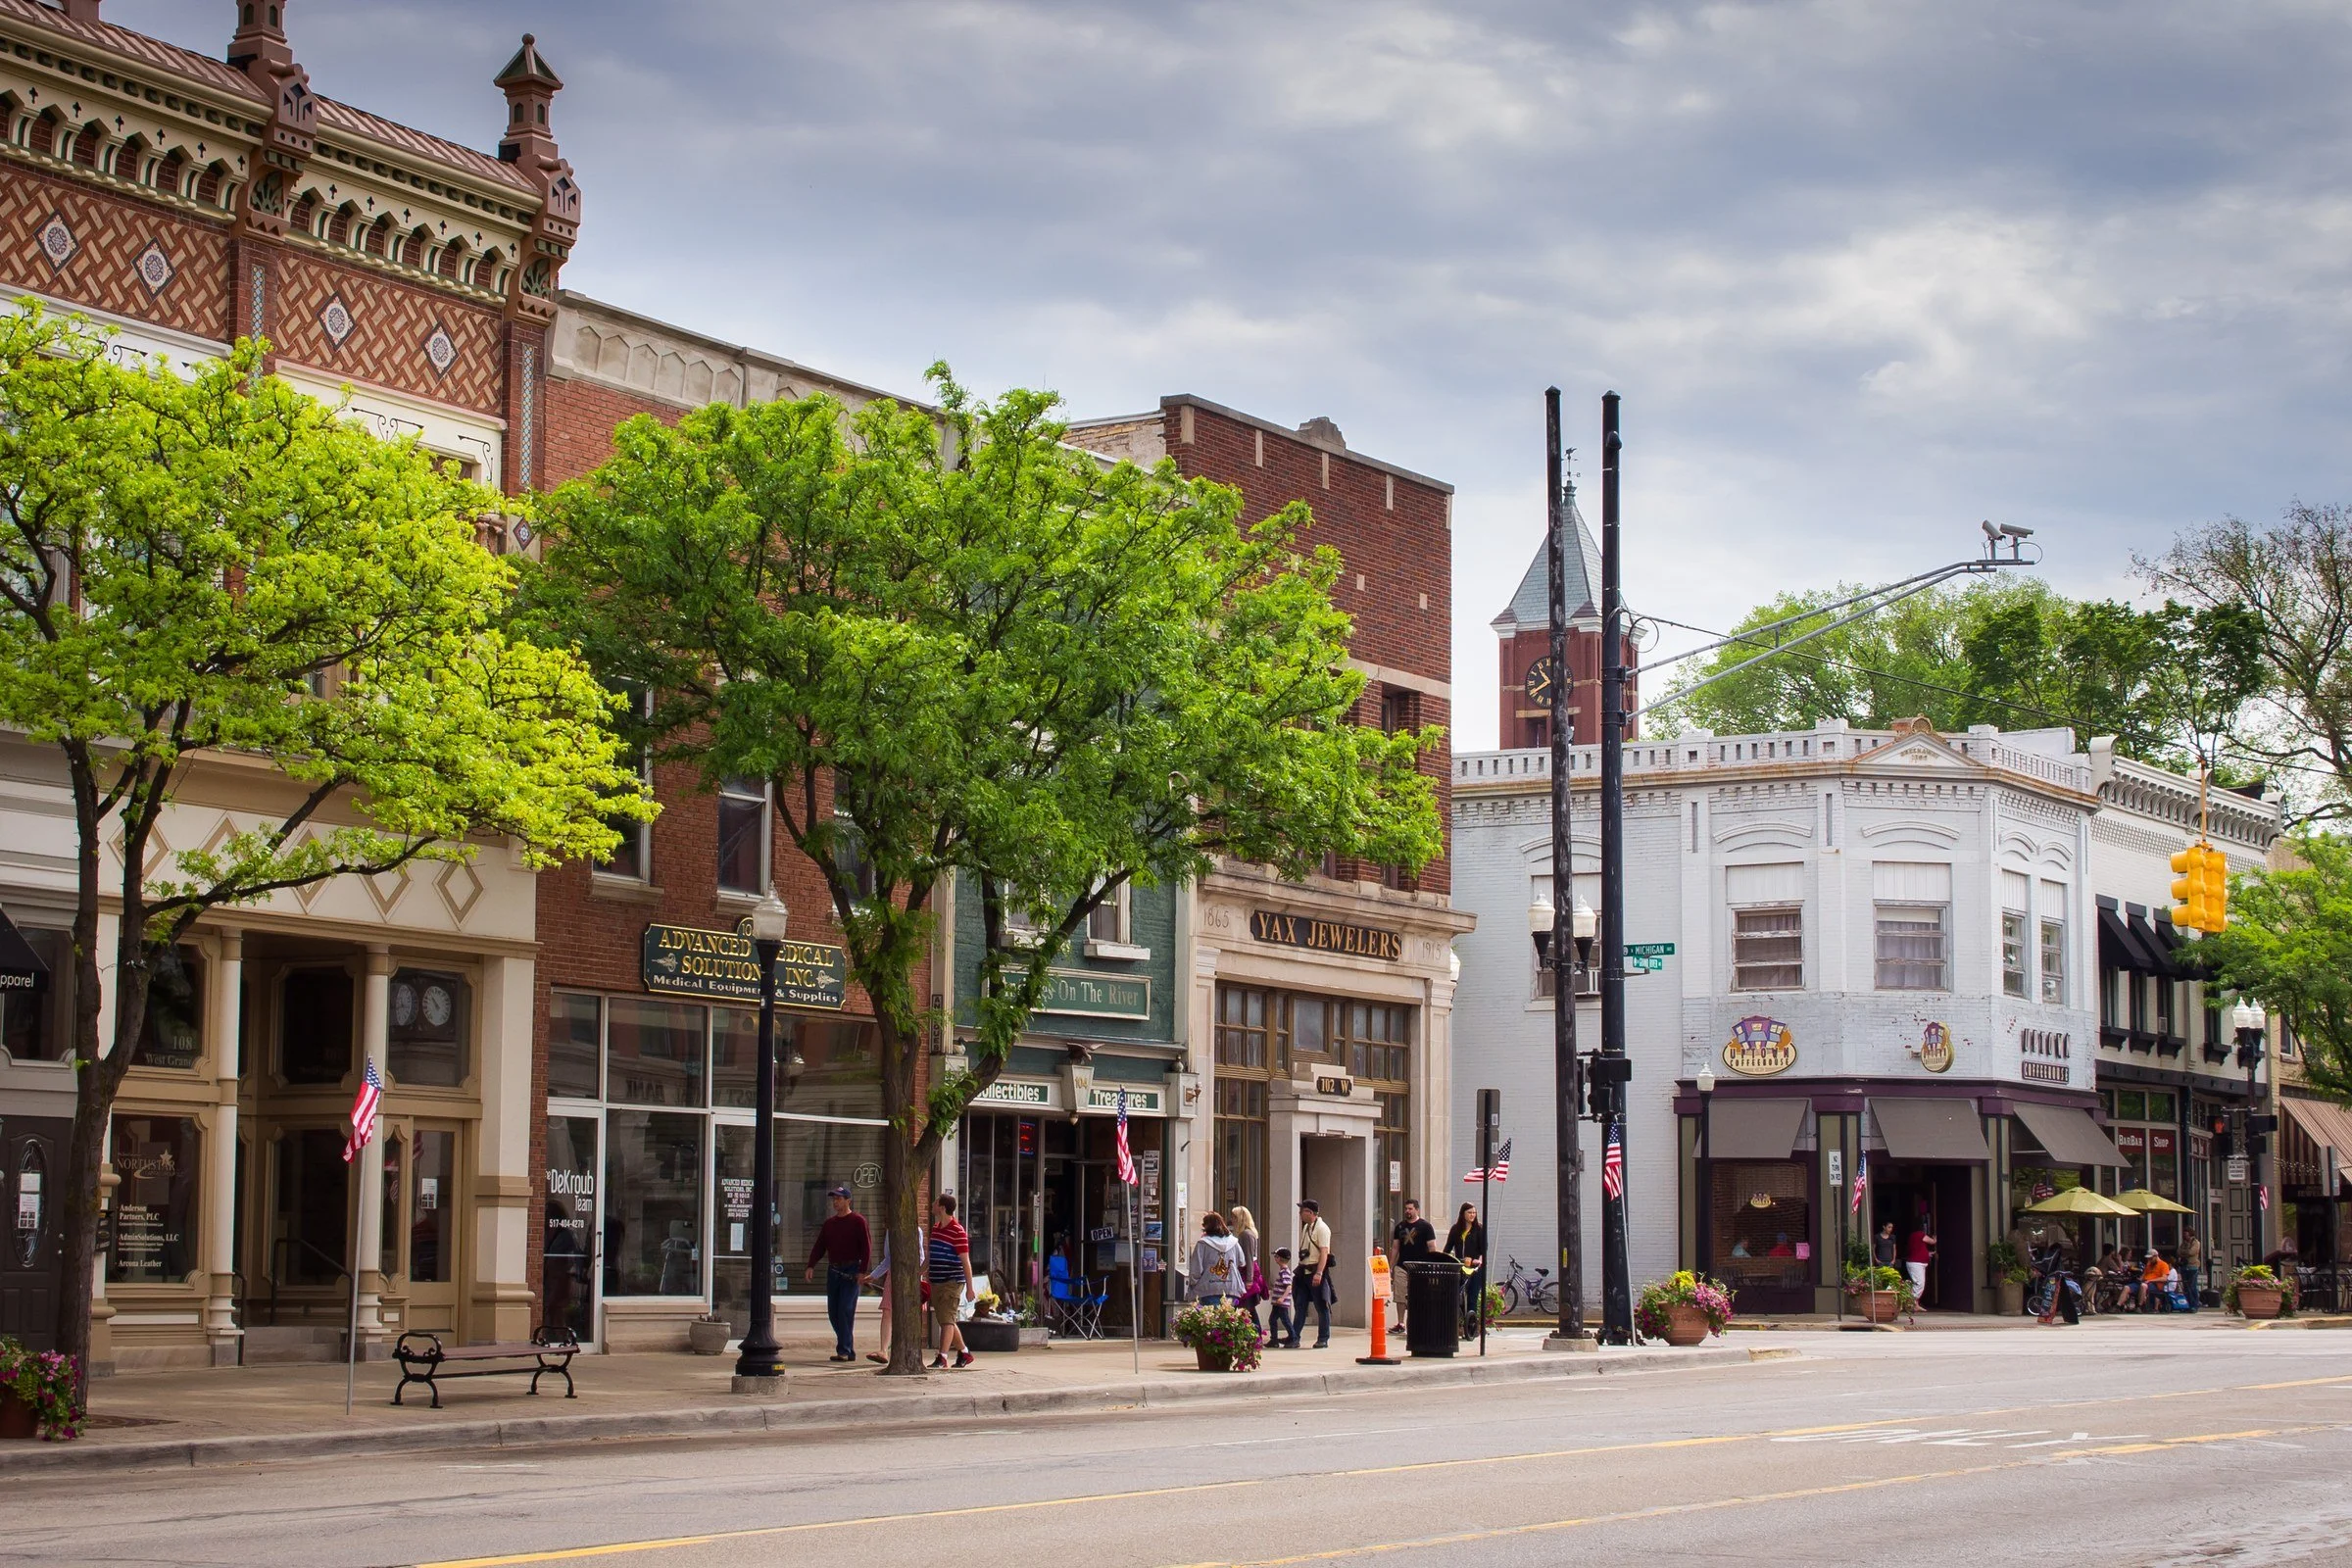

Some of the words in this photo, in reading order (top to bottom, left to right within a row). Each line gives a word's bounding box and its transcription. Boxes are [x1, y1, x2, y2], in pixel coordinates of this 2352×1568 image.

[1203, 909, 1229, 928] 1865
[742, 924, 753, 937] 10
[1258, 912, 1297, 943] YAX
[1308, 921, 1400, 957] JEWELERS
[659, 930, 752, 957] ADVANCED
[775, 945, 834, 967] EDICAL
[1422, 941, 1441, 959] 1915
[1635, 945, 1665, 956] MICHIGAN
[0, 972, 34, 989] pparel
[681, 956, 778, 985] SOLUTION,
[785, 967, 816, 988] INC.
[709, 981, 761, 995] Equipme
[775, 989, 785, 998] &
[789, 989, 838, 1003] Supplies
[1058, 980, 1077, 1001] On
[1081, 982, 1102, 1004] The
[1108, 984, 1139, 1006] River
[172, 1036, 193, 1051] 108
[145, 1054, 166, 1066] West
[1730, 1048, 1789, 1059] UPTOWN
[1075, 1077, 1088, 1089] 104
[1321, 1078, 1335, 1093] 102
[1341, 1080, 1349, 1094] W
[1094, 1090, 1148, 1108] Treaures
[551, 1168, 594, 1195] DeKroub
[853, 1166, 883, 1184] OPEN
[574, 1195, 593, 1212] Team
[119, 1212, 146, 1221] Partners,
[146, 1212, 160, 1221] PLC
[1092, 1229, 1113, 1241] OPEN
